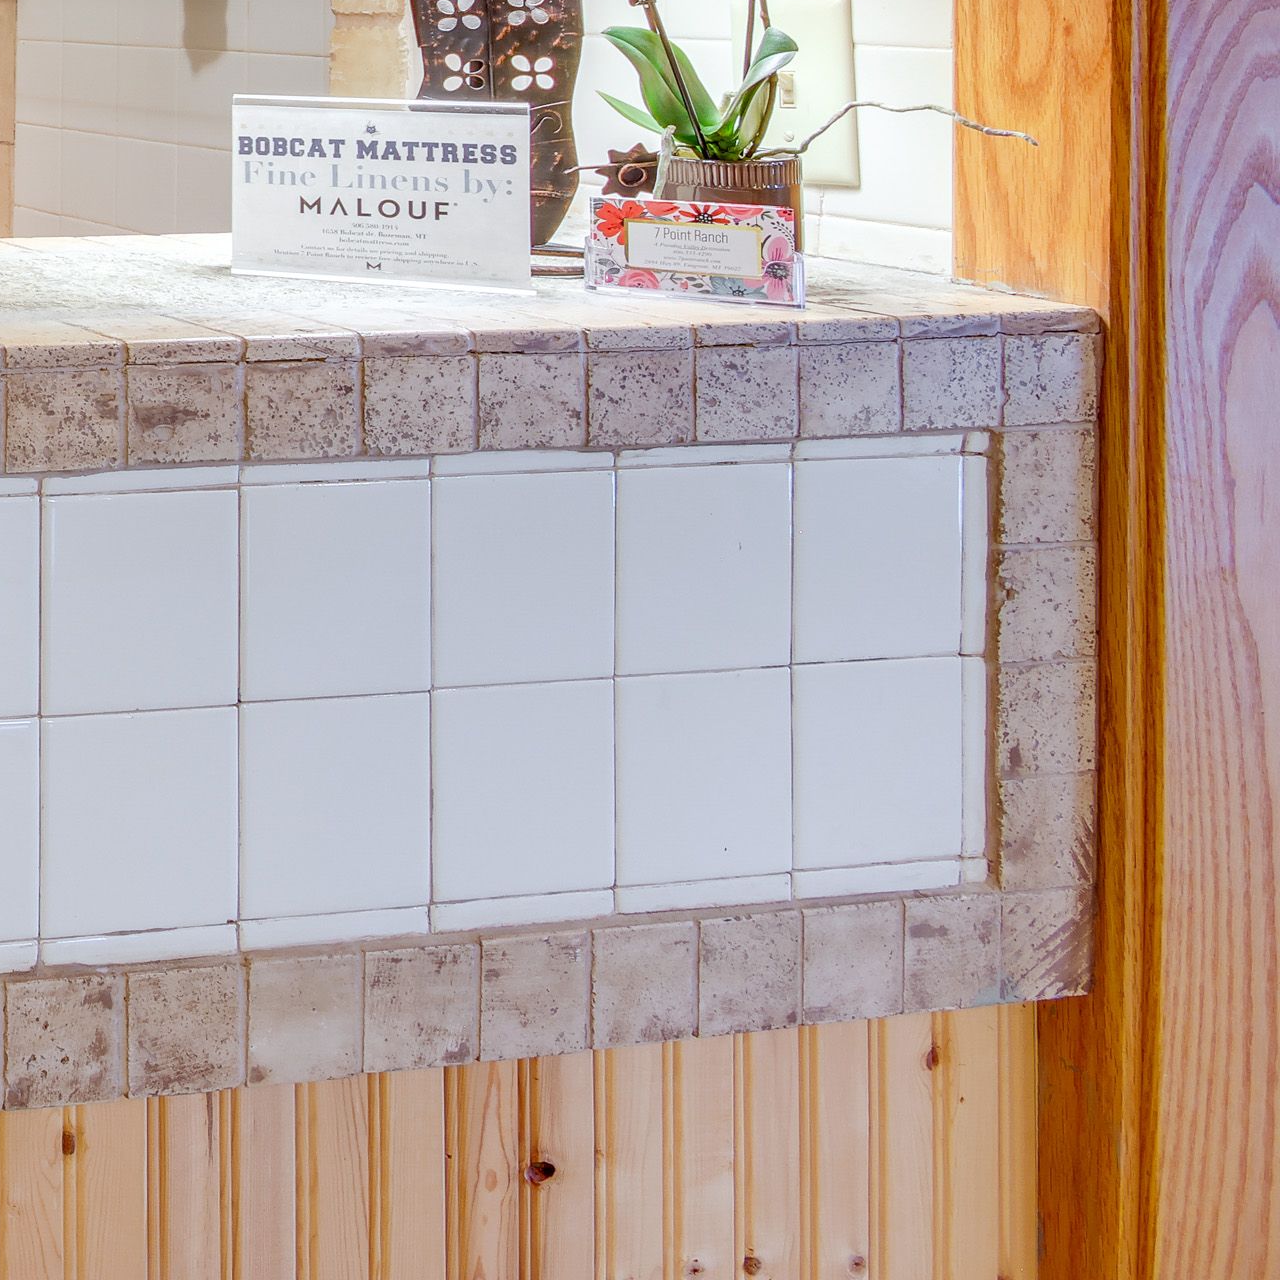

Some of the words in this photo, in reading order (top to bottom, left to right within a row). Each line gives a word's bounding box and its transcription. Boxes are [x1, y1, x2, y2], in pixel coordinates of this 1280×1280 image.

[238, 136, 345, 158] BOBCAT
[356, 139, 518, 165] MATTRESS
[242, 160, 316, 187] Fine
[329, 164, 449, 193] Linens
[462, 168, 513, 203] by:
[300, 195, 450, 221] MALOUF
[655, 227, 661, 238] 7
[663, 227, 692, 241] Point
[694, 229, 729, 244] Ranch
